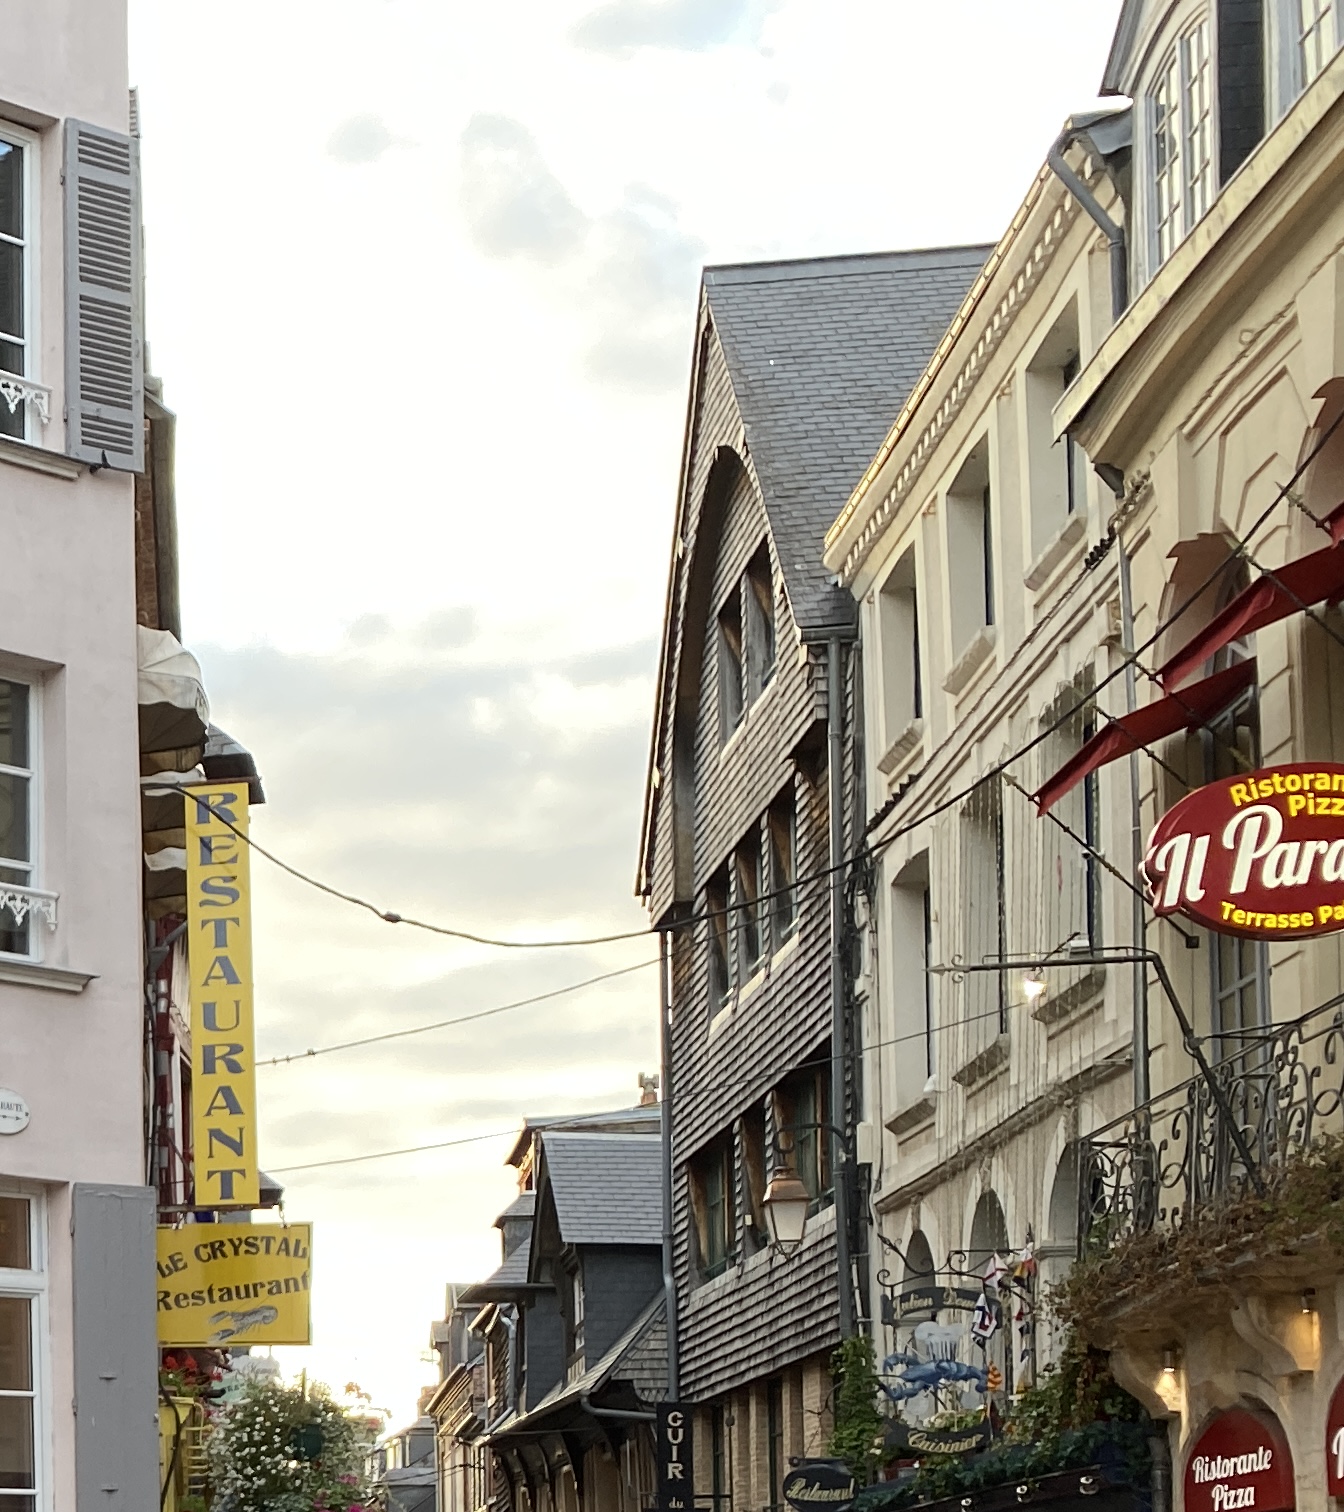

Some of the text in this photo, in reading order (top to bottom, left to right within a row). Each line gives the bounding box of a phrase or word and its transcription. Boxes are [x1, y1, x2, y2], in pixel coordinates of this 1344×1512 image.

[1229, 772, 1344, 807] Ristoran
[1288, 793, 1344, 817] Pizz
[1155, 833, 1210, 908] Il
[1221, 901, 1314, 929] Terrasse
[194, 792, 246, 1200] RESTAURANT
[157, 1235, 308, 1279] LE CRYSTAL
[157, 1269, 309, 1312] Restaurant
[667, 1411, 685, 1480] CUIR
[907, 1430, 985, 1454] Cuisinier
[1192, 1446, 1273, 1484] Ristorante
[668, 1497, 685, 1509] du
[786, 1478, 856, 1501] Restaurant
[1212, 1484, 1255, 1512] Pizza
